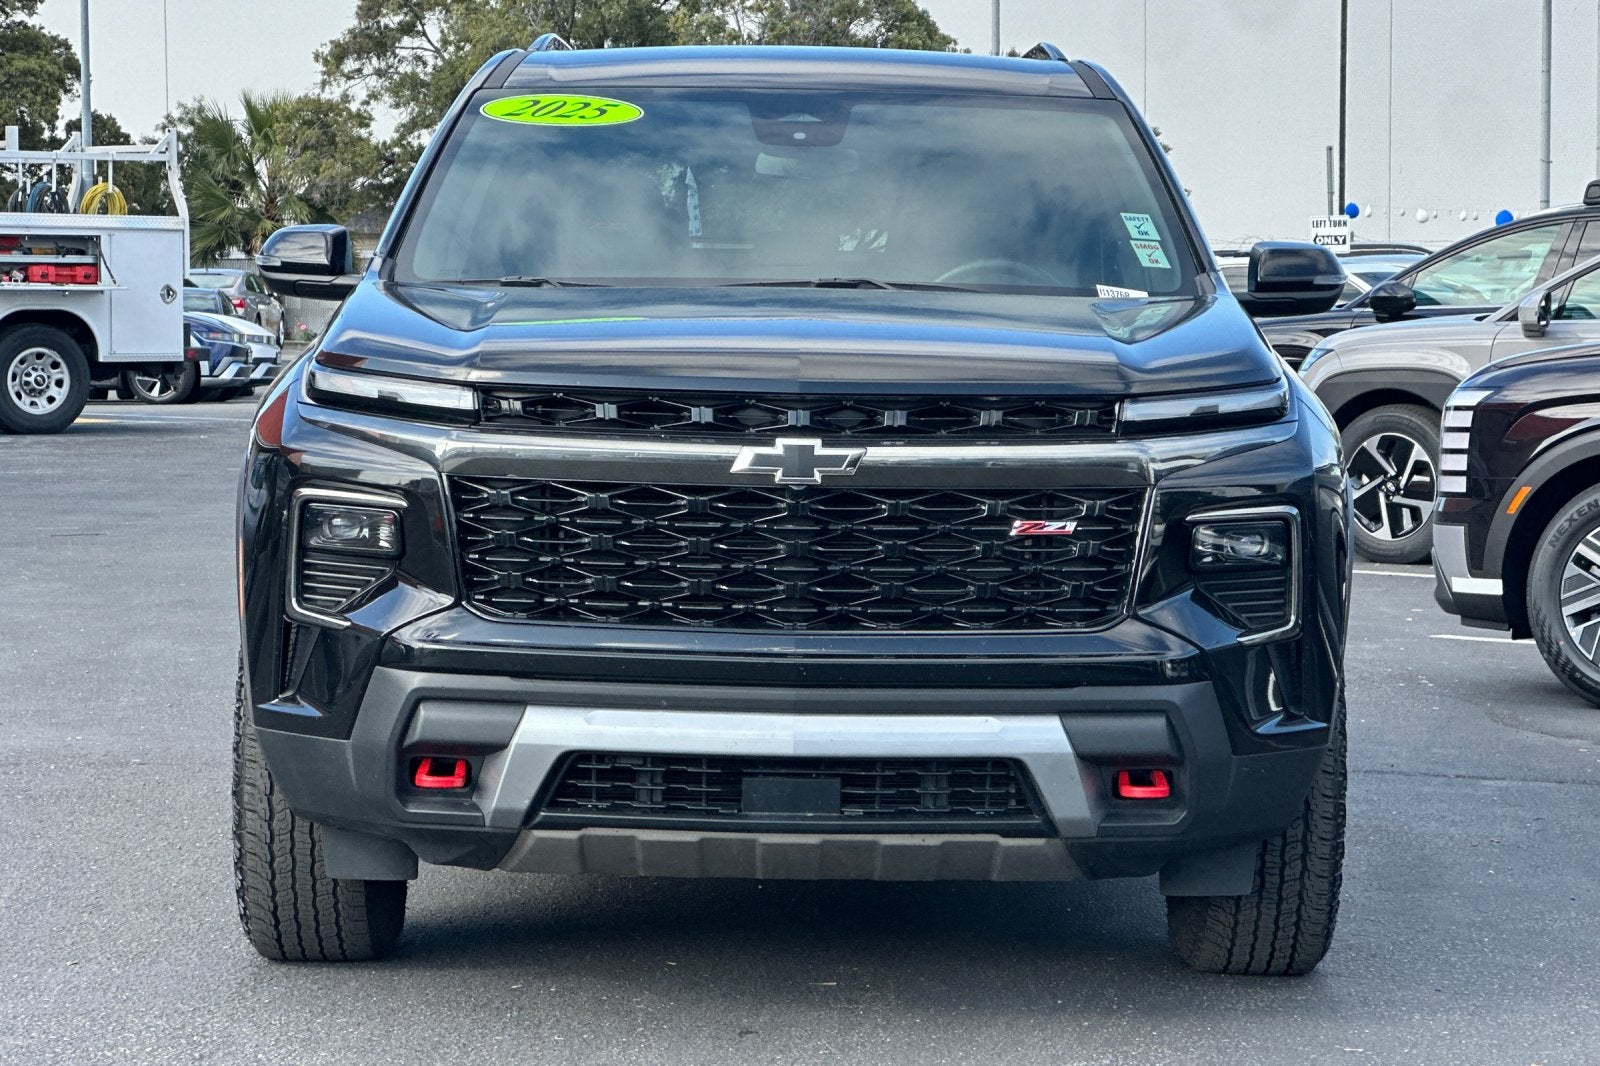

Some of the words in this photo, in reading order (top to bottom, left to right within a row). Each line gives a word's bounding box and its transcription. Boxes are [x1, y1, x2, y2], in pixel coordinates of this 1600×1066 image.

[501, 99, 621, 120] 2025
[1123, 215, 1149, 223] SAFETY
[1312, 219, 1327, 228] LEFT
[1329, 219, 1348, 228] TURN
[1315, 236, 1345, 245] ONLY
[1009, 520, 1078, 535] Z71
[1547, 498, 1600, 549] NEXEN
